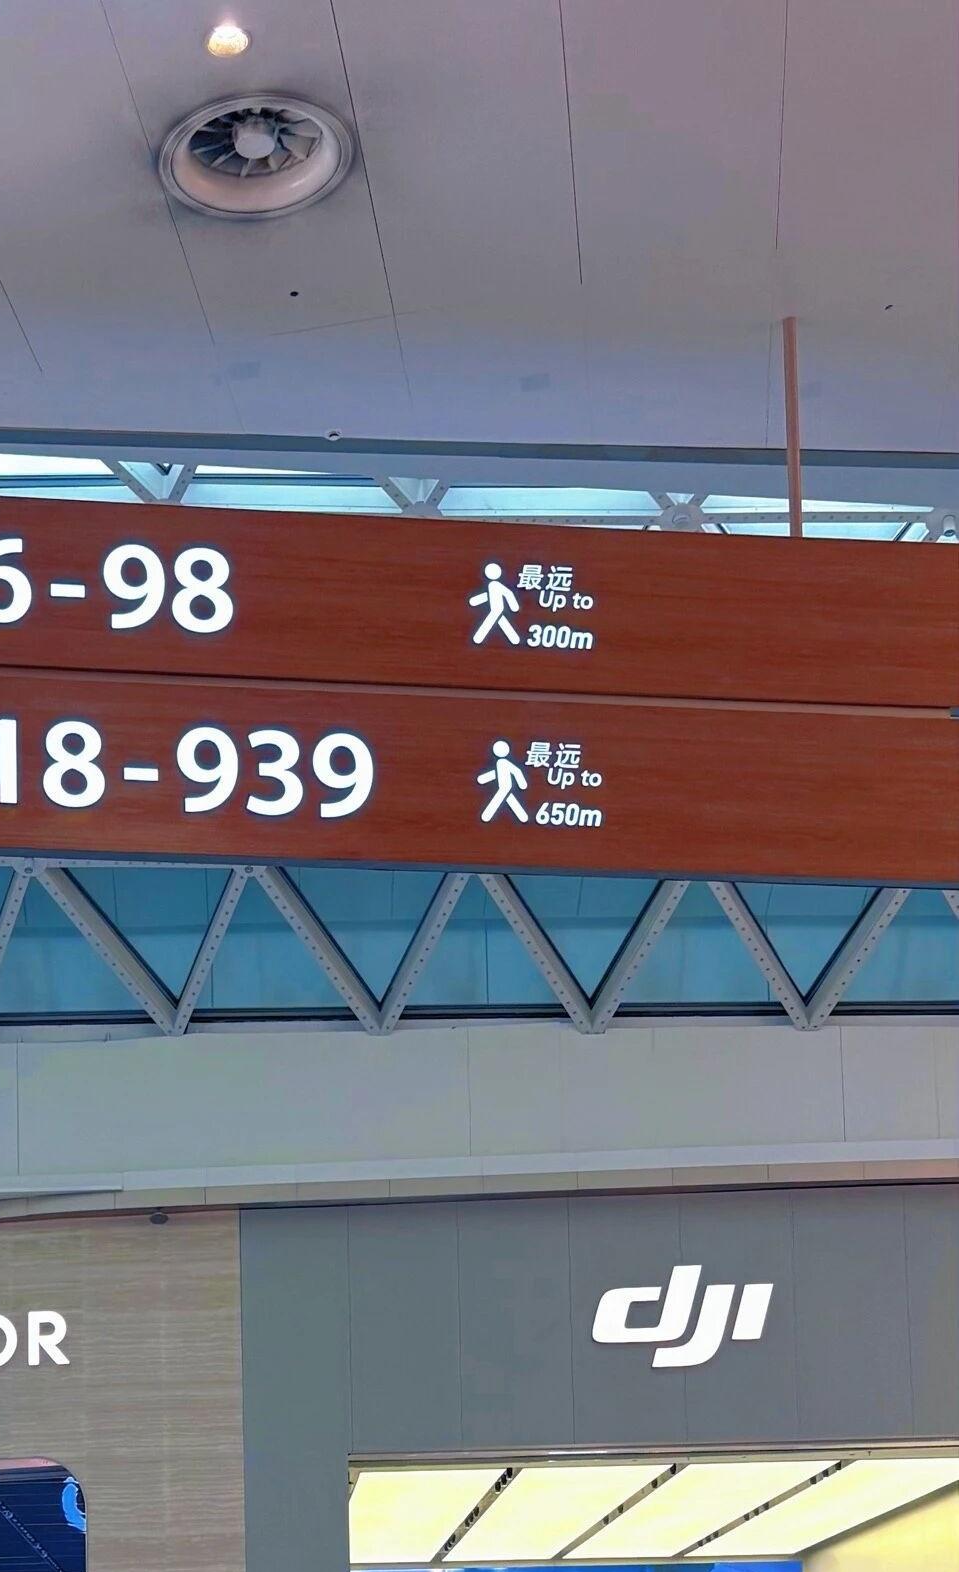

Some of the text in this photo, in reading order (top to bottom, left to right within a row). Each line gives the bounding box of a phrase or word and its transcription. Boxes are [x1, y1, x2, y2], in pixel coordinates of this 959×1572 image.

[517, 564, 573, 592] 最远
[539, 590, 594, 612] Up to
[527, 624, 593, 650] 300m
[525, 741, 582, 769] 最远
[547, 768, 602, 790] Up to
[535, 802, 602, 827] 650m
